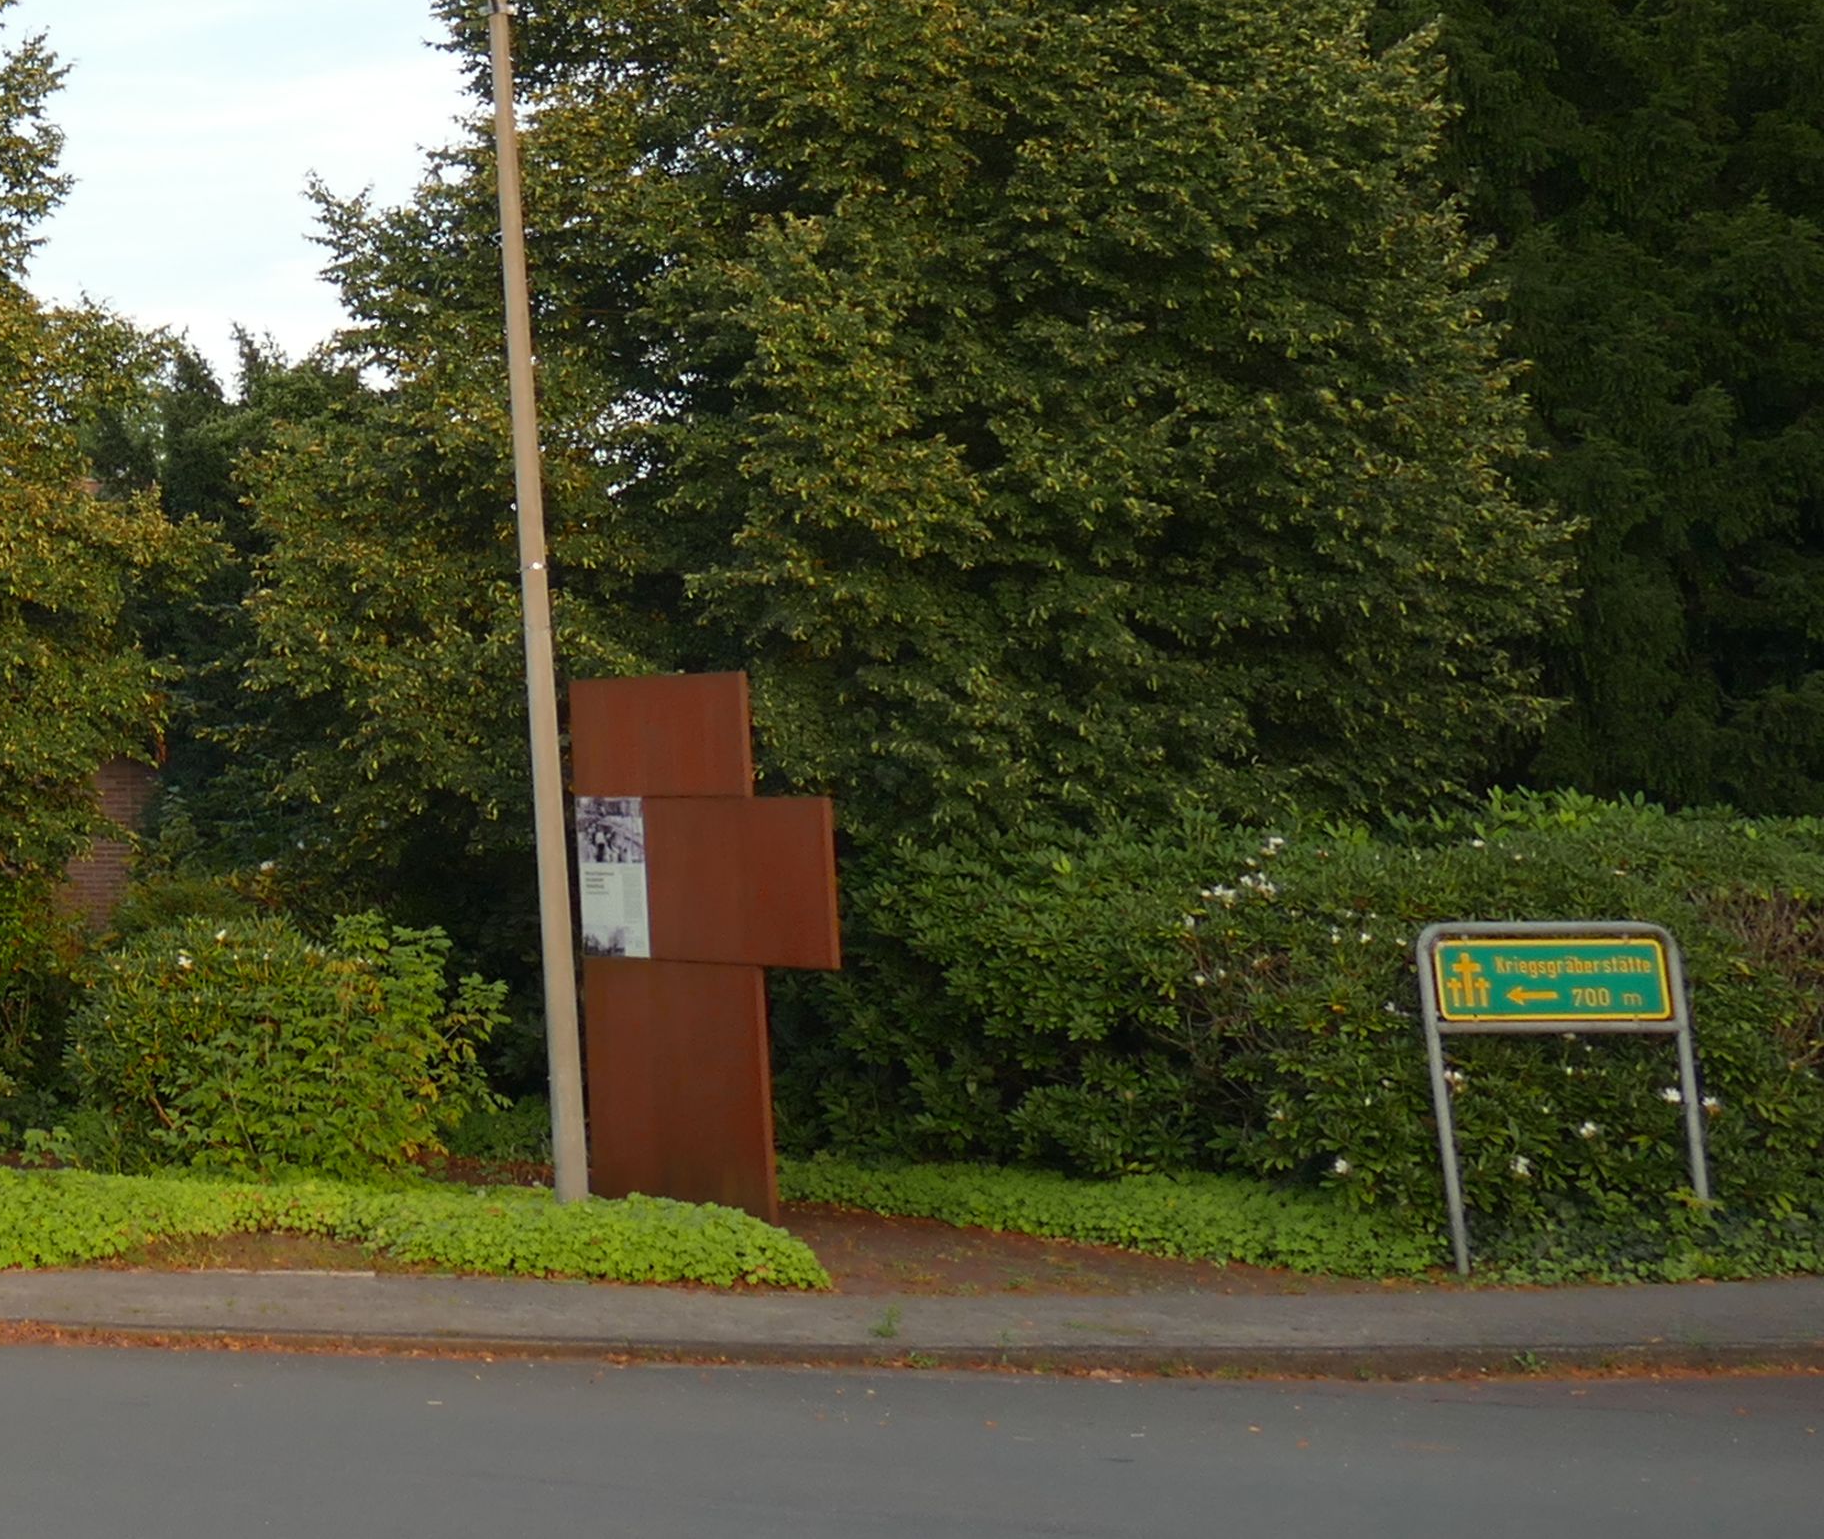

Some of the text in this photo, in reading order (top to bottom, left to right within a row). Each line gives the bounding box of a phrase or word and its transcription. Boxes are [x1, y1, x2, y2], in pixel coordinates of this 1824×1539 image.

[1494, 955, 1652, 979] Kriegsgräberstätte
[1571, 987, 1643, 1006] 700 m
